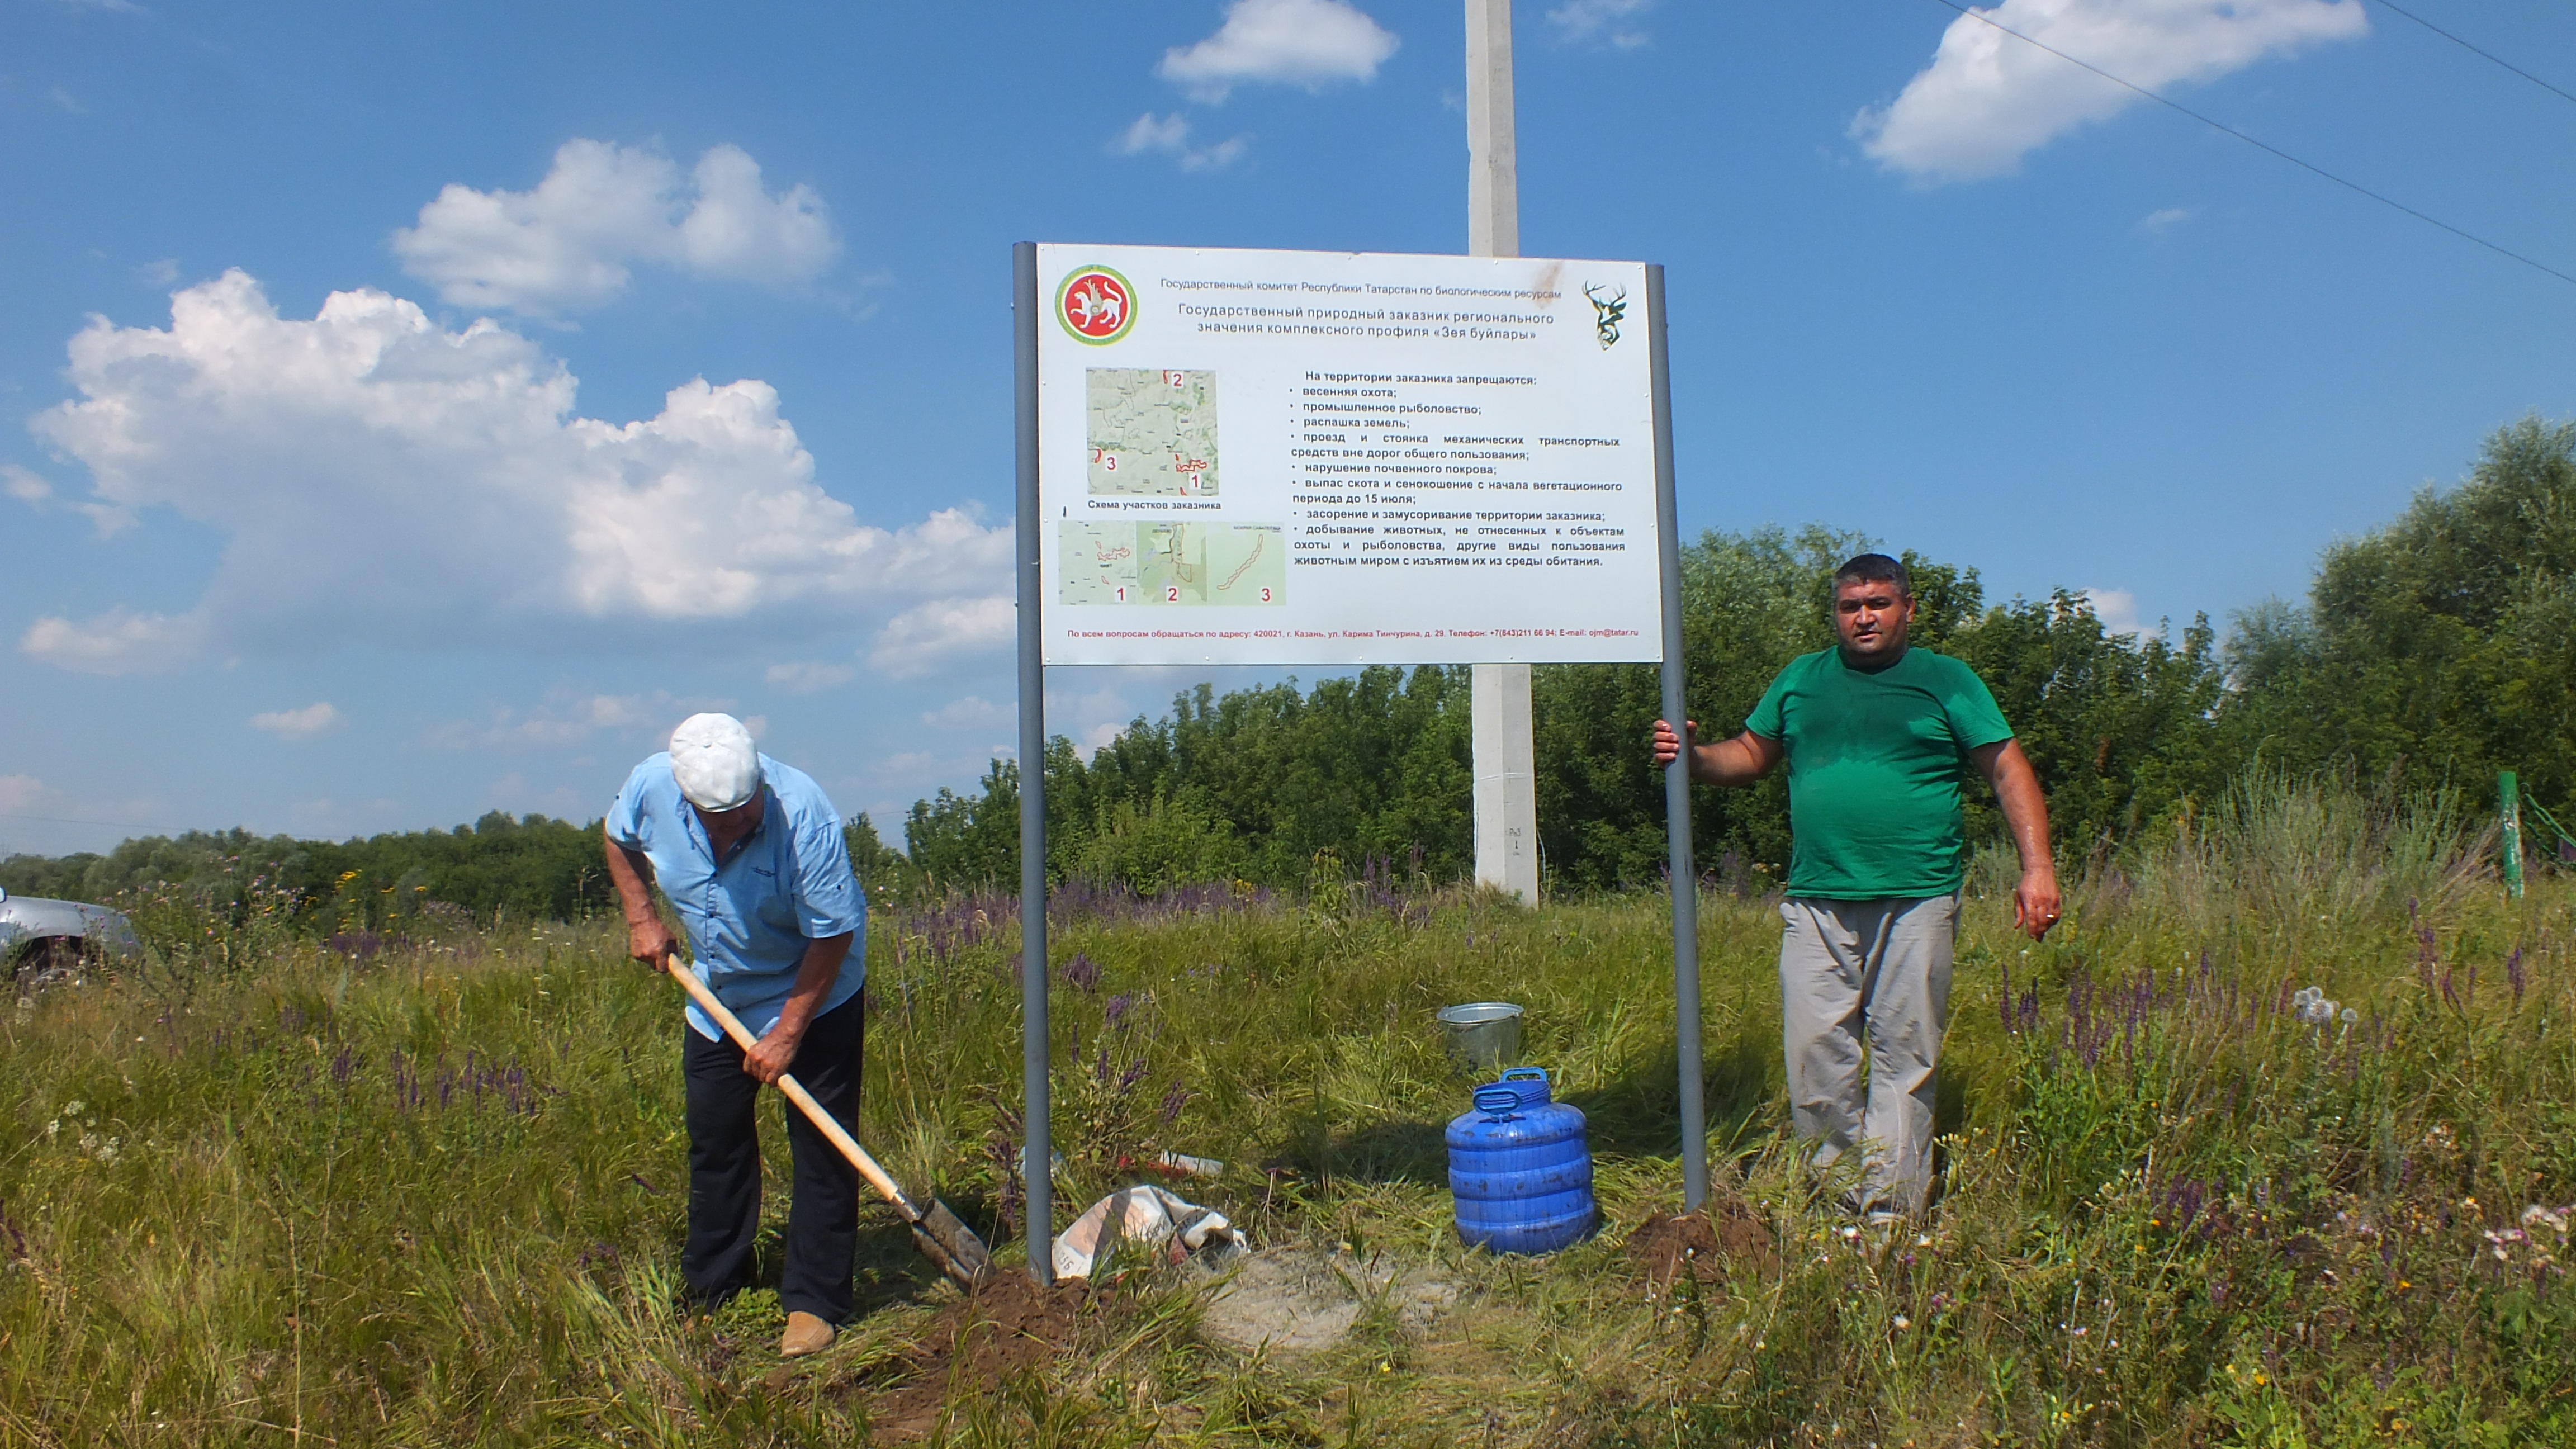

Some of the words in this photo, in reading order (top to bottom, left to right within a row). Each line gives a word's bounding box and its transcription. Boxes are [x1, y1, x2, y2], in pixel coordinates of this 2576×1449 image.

[1161, 278, 1253, 290] Государственный
[1302, 282, 1361, 294] Республики
[1365, 283, 1417, 296] Татарстан
[1436, 286, 1512, 297] биологическим
[1514, 290, 1561, 301] ресурсам
[1179, 304, 1303, 318] Государственный
[1308, 309, 1384, 320] природный
[1389, 312, 1449, 320] заказник
[1454, 314, 1554, 324] регионального
[1198, 323, 1262, 333] значения
[1268, 325, 1363, 335] комплексного
[1368, 326, 1428, 338] профиля
[1470, 327, 1536, 341] буйлары»
[1173, 373, 1182, 386] 2
[1306, 371, 1320, 380] На
[1324, 373, 1392, 383] территории
[1457, 376, 1536, 385] запрещаются:
[1303, 388, 1357, 396] весенняя
[1361, 390, 1396, 398] охота;
[1304, 404, 1395, 413] промышленное
[1399, 404, 1481, 415] рыболовство;
[1304, 419, 1360, 428] распашка
[1364, 420, 1409, 429] земель;
[1304, 434, 1346, 443] проезд
[1539, 438, 1620, 447] транспортных
[1291, 449, 1338, 458] средств
[1366, 450, 1400, 460] дорог
[1405, 448, 1447, 459] общего
[1451, 452, 1528, 461] пользования;
[1107, 457, 1116, 470] 3
[1305, 465, 1370, 474] нарушение
[1446, 466, 1496, 476] покрова;
[1192, 475, 1197, 487] 1
[1533, 483, 1622, 491] вегетационного
[1293, 495, 1342, 504] периода
[1346, 496, 1361, 504] до
[1366, 494, 1377, 503] 15
[1381, 496, 1415, 505] июля;
[1307, 511, 1368, 520] засорение
[1383, 512, 1472, 521] замусоривание
[1476, 512, 1542, 522] территории
[1546, 513, 1605, 522] заказника;
[1306, 524, 1374, 534] добывание
[1384, 527, 1445, 536] животных,
[1570, 526, 1624, 536] объектам
[1363, 540, 1445, 551] рыболовства,
[1457, 543, 1496, 552] другие
[1509, 543, 1539, 551] виды
[1361, 558, 1399, 567] миром
[1506, 558, 1542, 567] среды
[1546, 556, 1602, 566] обитания.
[1117, 588, 1124, 601] 1
[1168, 588, 1177, 601] 2
[1262, 588, 1270, 601] 3
